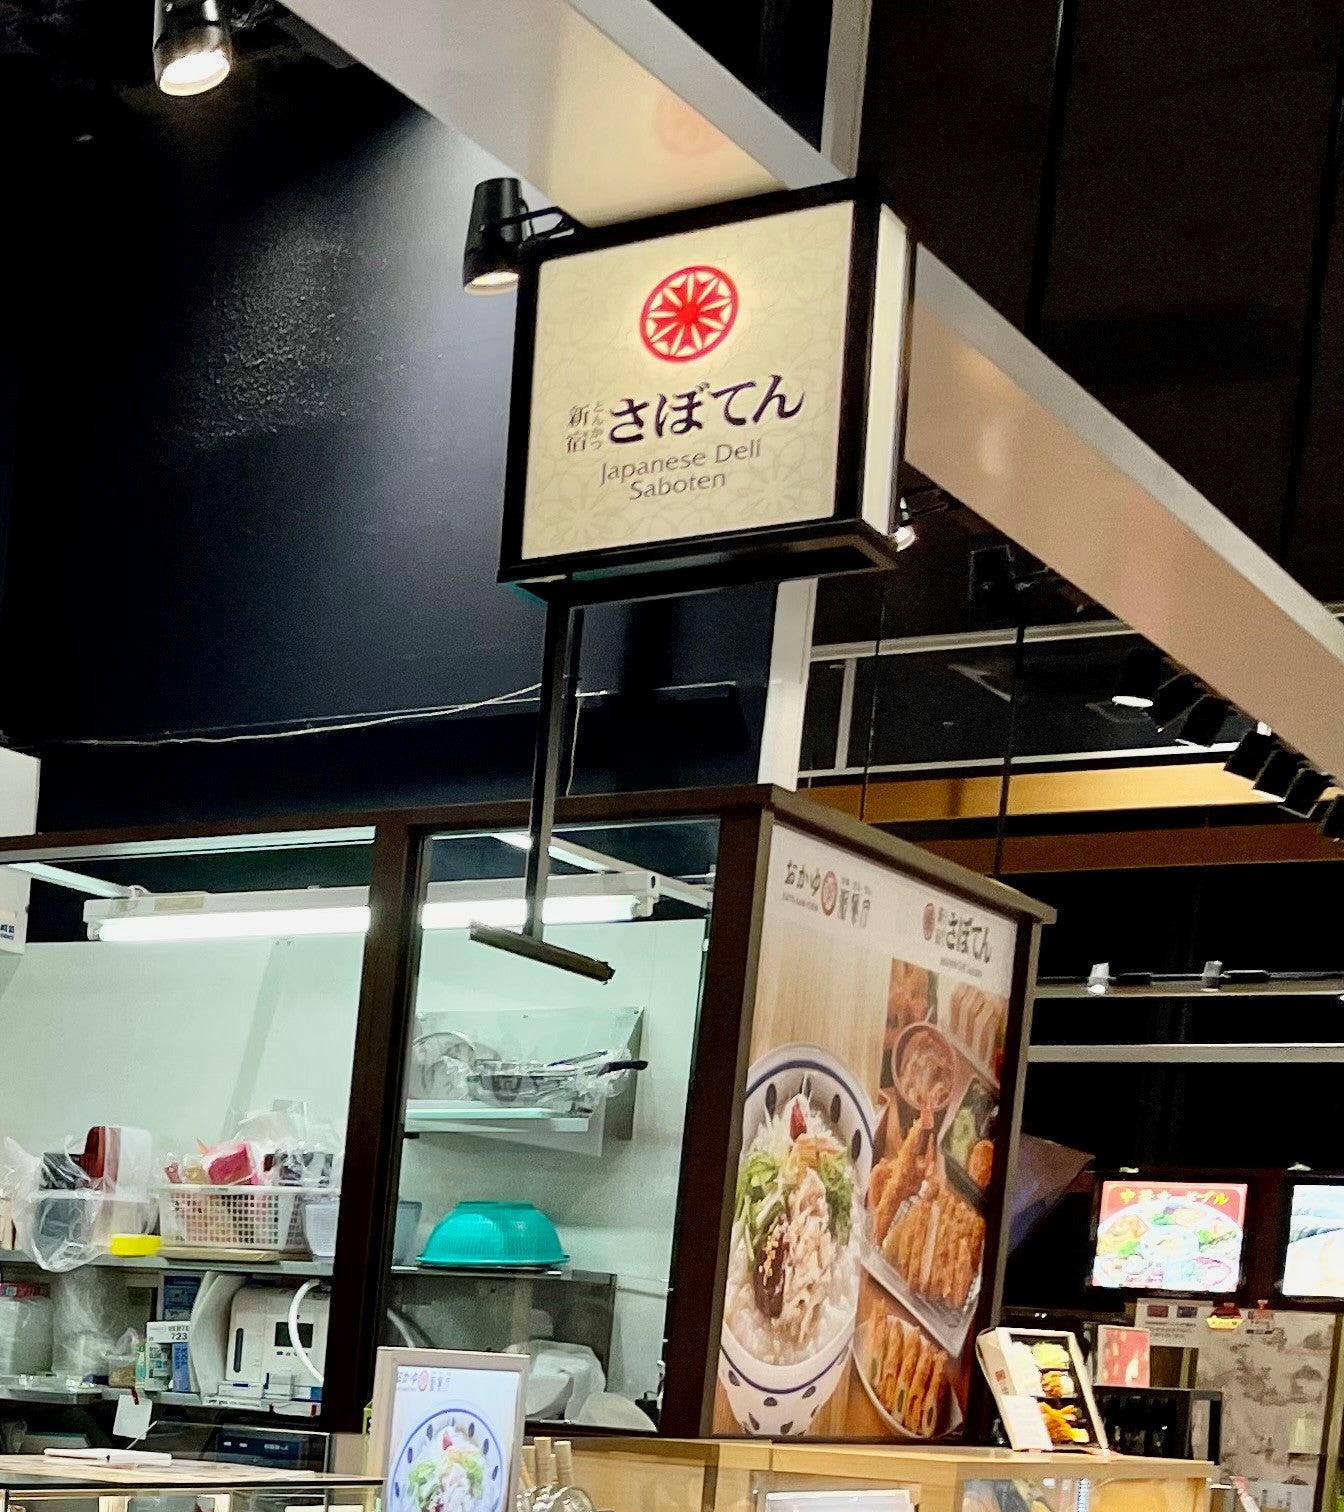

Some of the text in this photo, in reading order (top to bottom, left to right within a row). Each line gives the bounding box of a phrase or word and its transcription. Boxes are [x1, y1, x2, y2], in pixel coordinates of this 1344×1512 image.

[566, 404, 592, 454] 新宿
[609, 375, 804, 443] さぼてん
[601, 439, 762, 486] Japanese Deli
[630, 472, 726, 500] Saboten
[946, 912, 993, 963] さぼてん
